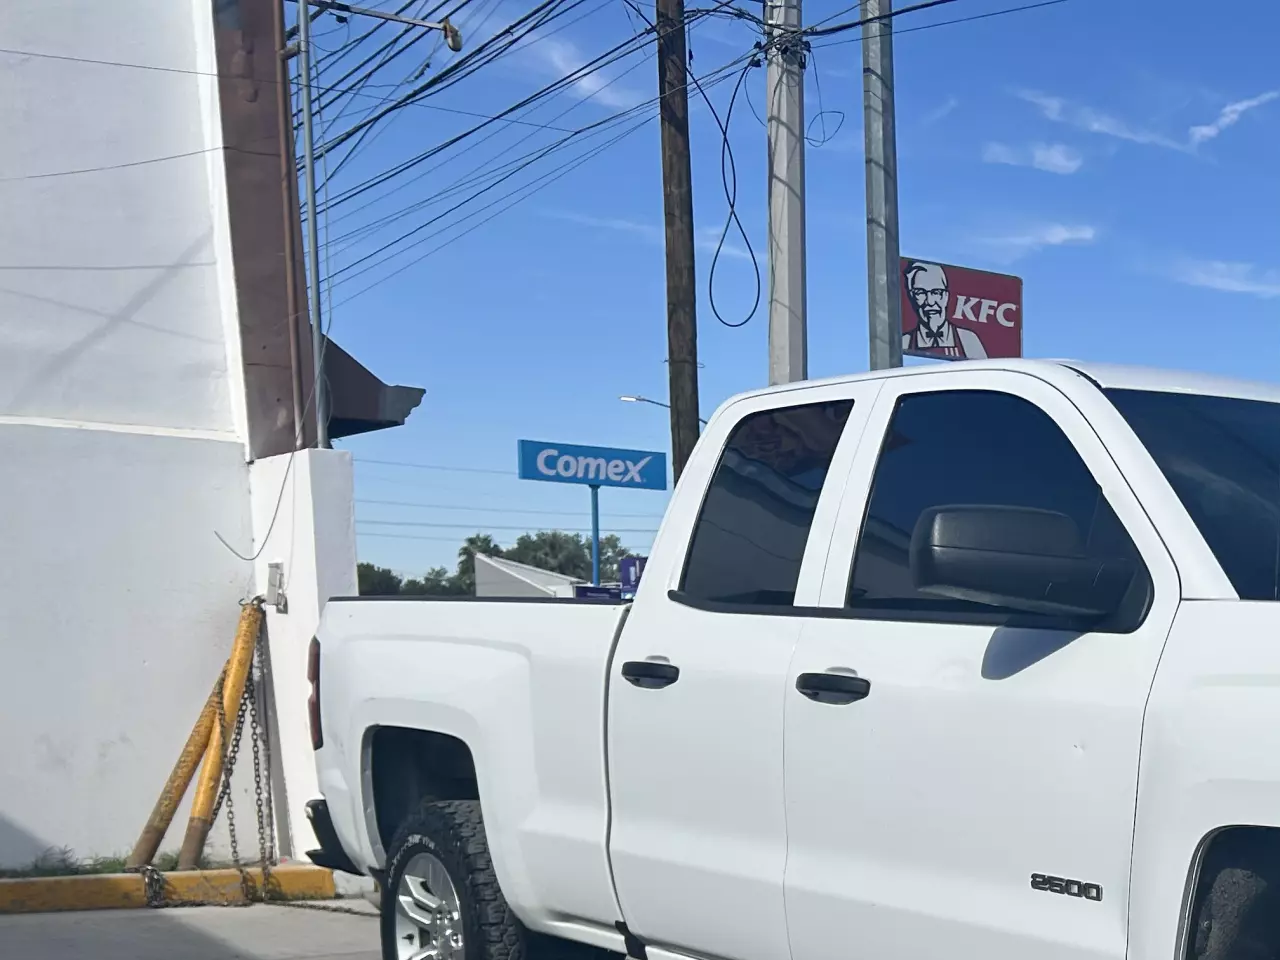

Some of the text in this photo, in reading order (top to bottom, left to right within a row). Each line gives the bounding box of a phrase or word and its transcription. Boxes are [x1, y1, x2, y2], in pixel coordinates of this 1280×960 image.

[952, 294, 1017, 328] KFC
[536, 448, 653, 483] Comex
[1030, 872, 1103, 902] 2500
